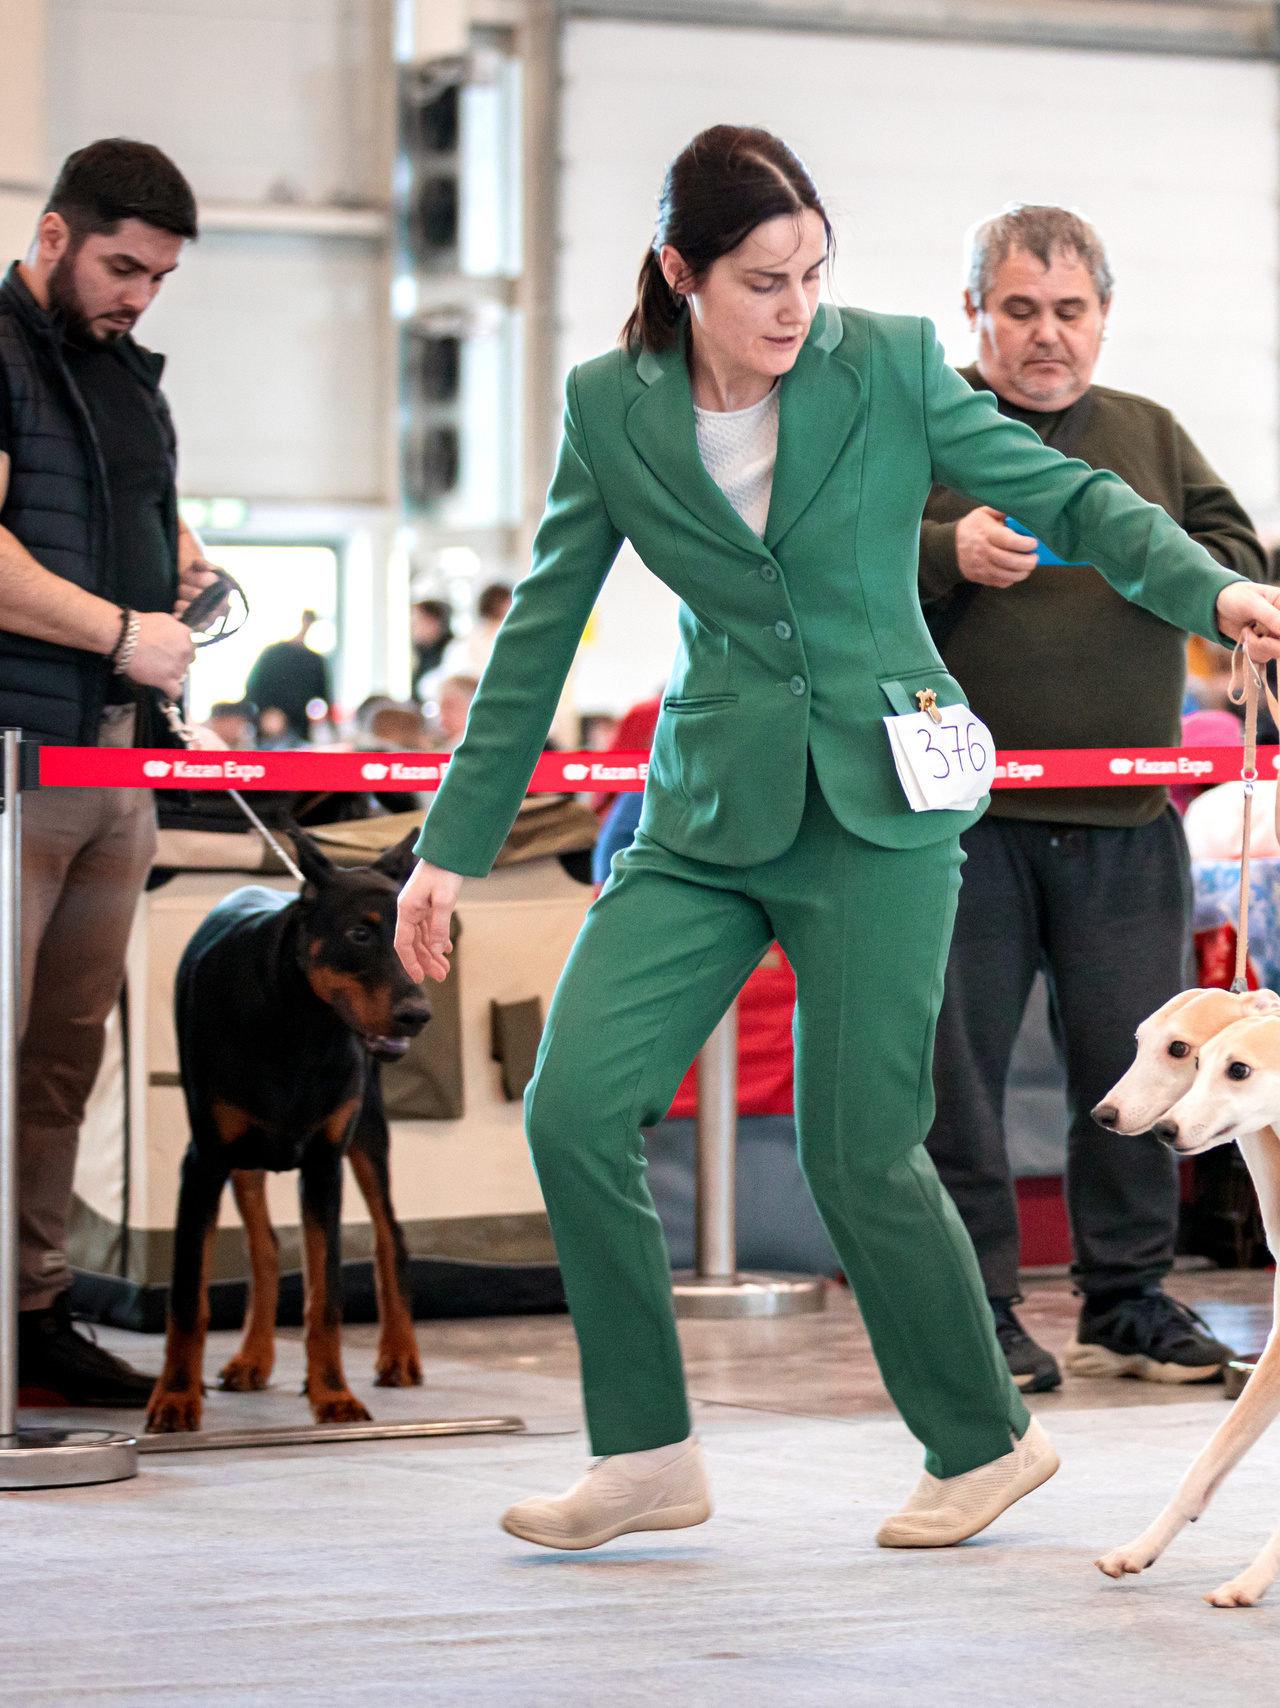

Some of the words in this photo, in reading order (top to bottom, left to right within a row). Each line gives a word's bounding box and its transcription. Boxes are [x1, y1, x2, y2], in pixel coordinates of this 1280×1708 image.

[916, 722, 986, 779] 376
[173, 760, 223, 778] Kazan
[224, 761, 265, 782] Expo
[390, 763, 439, 780] Kazan
[591, 763, 637, 780] Kazan
[1007, 761, 1044, 781] Expo
[1134, 758, 1177, 774] Kazan
[1177, 757, 1213, 777] Expo
